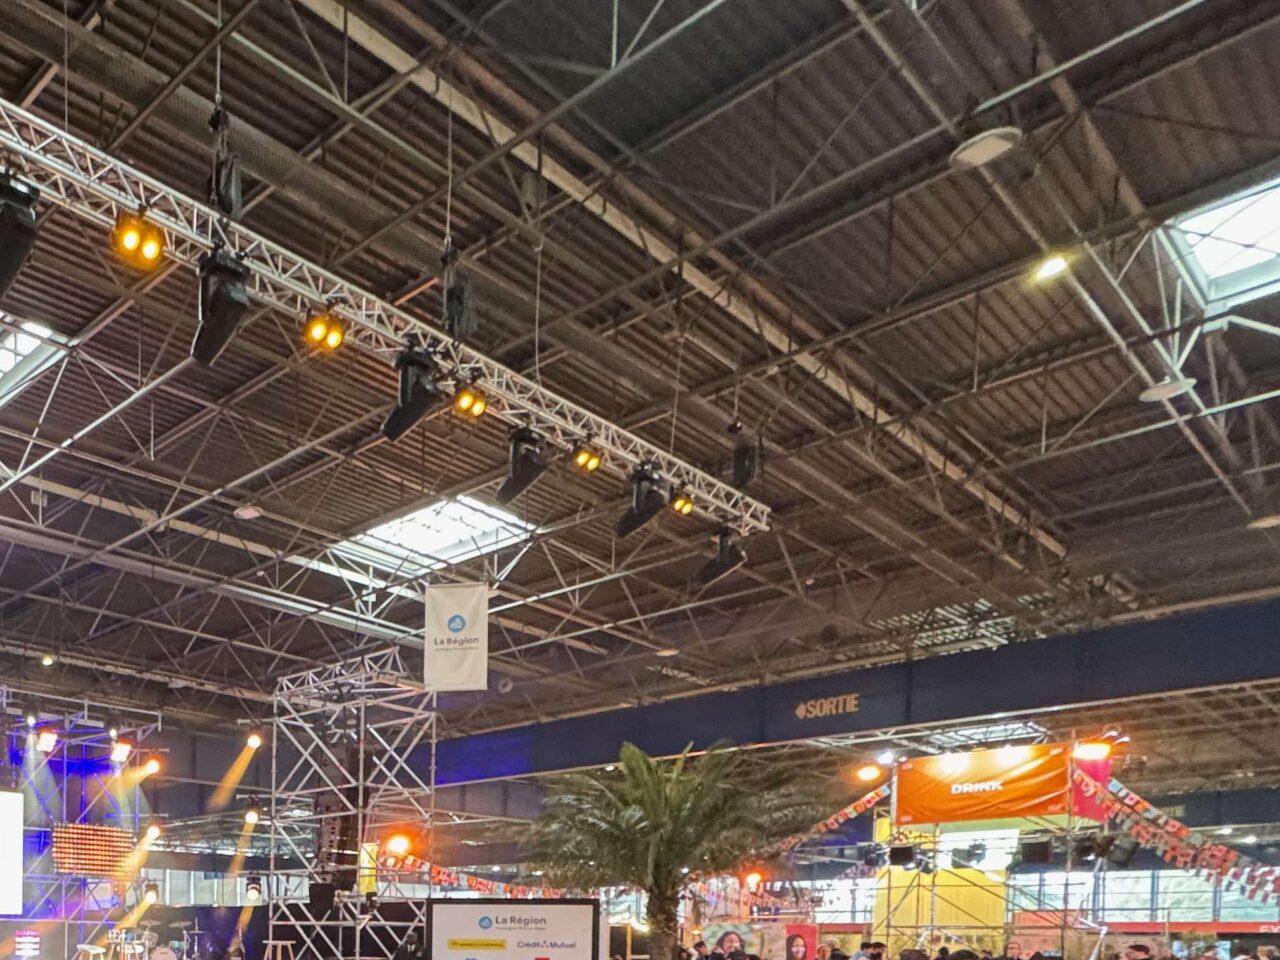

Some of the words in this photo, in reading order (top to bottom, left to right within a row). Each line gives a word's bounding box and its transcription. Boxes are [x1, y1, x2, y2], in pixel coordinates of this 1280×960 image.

[434, 637, 445, 646] La
[447, 636, 479, 646] Région
[806, 693, 860, 718] SORTIE
[951, 780, 1004, 795] DRINK
[495, 915, 507, 925] La
[510, 915, 547, 926] Région
[516, 940, 540, 949] Crédit
[549, 940, 576, 949] Mutuel
